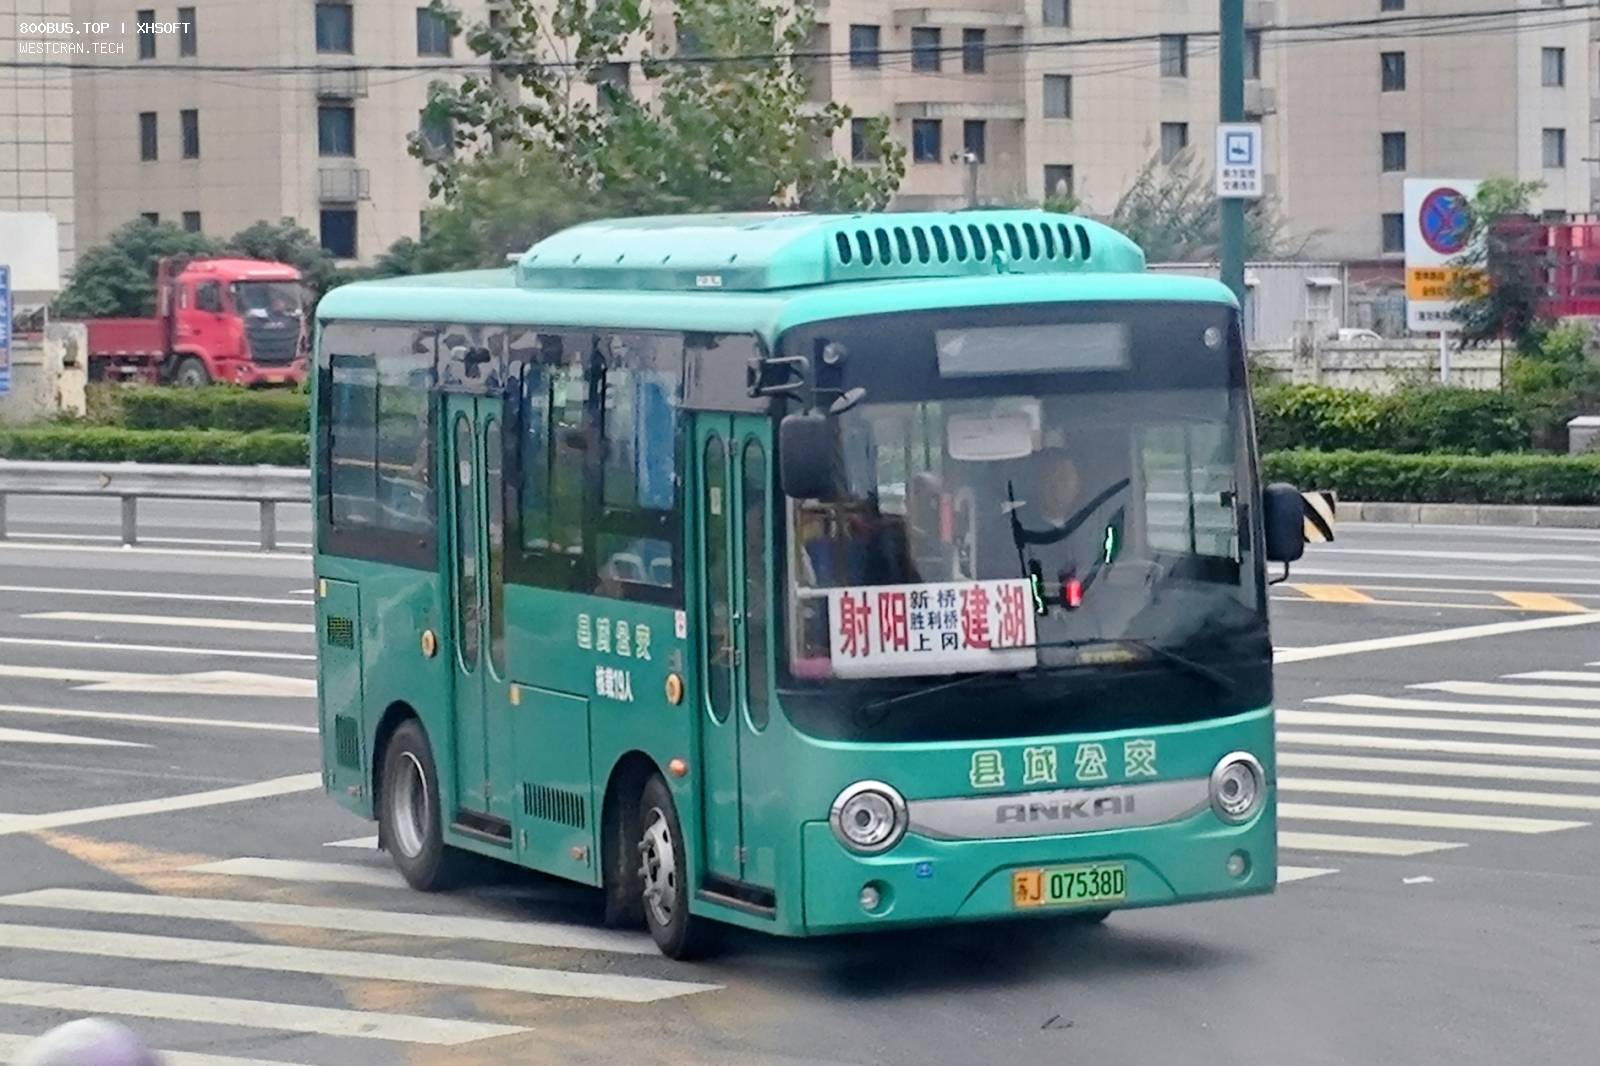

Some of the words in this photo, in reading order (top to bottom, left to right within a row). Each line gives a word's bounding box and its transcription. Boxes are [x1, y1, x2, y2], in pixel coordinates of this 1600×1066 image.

[910, 588, 957, 609] 新桥
[839, 590, 909, 657] 射阳
[910, 609, 959, 630] 胜利桥
[961, 583, 1026, 650] 建湖
[913, 631, 959, 651] 上冈
[970, 738, 1158, 789] 县域公交
[995, 794, 1136, 824] ANKAI
[1050, 868, 1125, 900] 07538D
